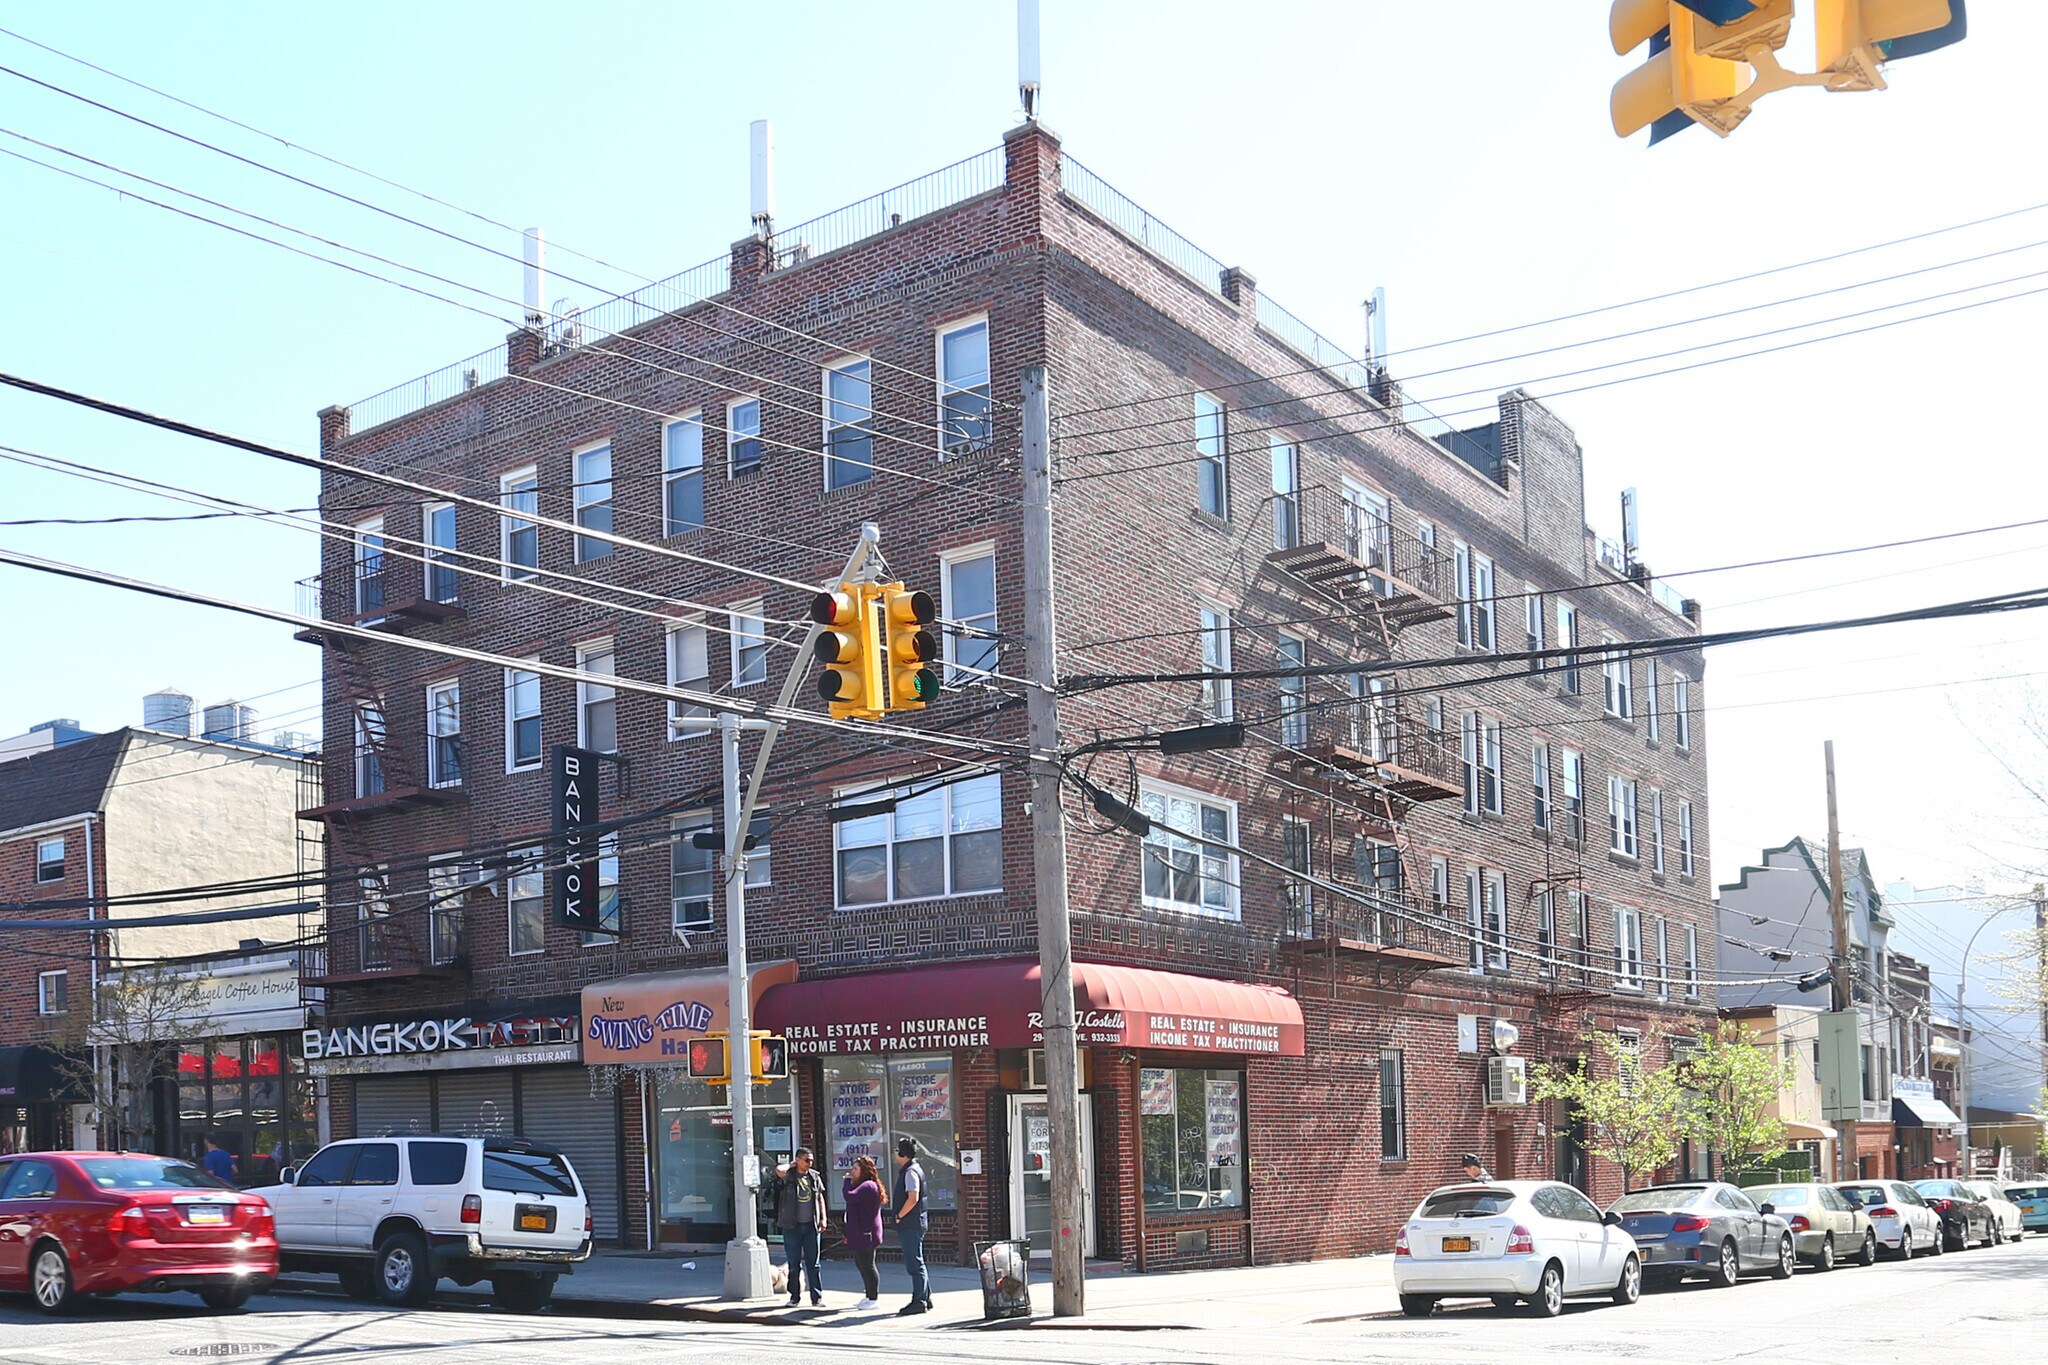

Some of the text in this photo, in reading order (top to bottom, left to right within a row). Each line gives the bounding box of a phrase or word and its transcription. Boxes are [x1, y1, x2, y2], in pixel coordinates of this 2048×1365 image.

[225, 982, 259, 1001] Coffee
[262, 979, 296, 994] House
[602, 997, 625, 1012] New
[589, 1001, 713, 1049] SWING TIME
[785, 1017, 987, 1039] REAL ESTATE INSURANCE
[1150, 1017, 1278, 1038] REAL ESTATE INSURANCE
[302, 1015, 576, 1059] BANGKOK TASTY
[788, 1033, 989, 1053] NCOME TAX PRACTITIONER
[1091, 1033, 1120, 1043] 932-3333
[1150, 1032, 1279, 1052] INCOME TAX PRACTITIONER
[493, 1050, 572, 1065] THAI RESTAURANT
[904, 1075, 936, 1085] STORE
[1143, 1070, 1165, 1079] STORE
[839, 1083, 870, 1095] STORE
[902, 1088, 943, 1097] For Rent
[832, 1096, 878, 1108] FOR RENT
[835, 1114, 877, 1124] AMERICA
[1209, 1114, 1235, 1123] AMERICA
[839, 1126, 874, 1137] REALTY
[1031, 1128, 1048, 1137] FOR
[1211, 1126, 1234, 1136] REALTY
[846, 1144, 869, 1156] (917)
